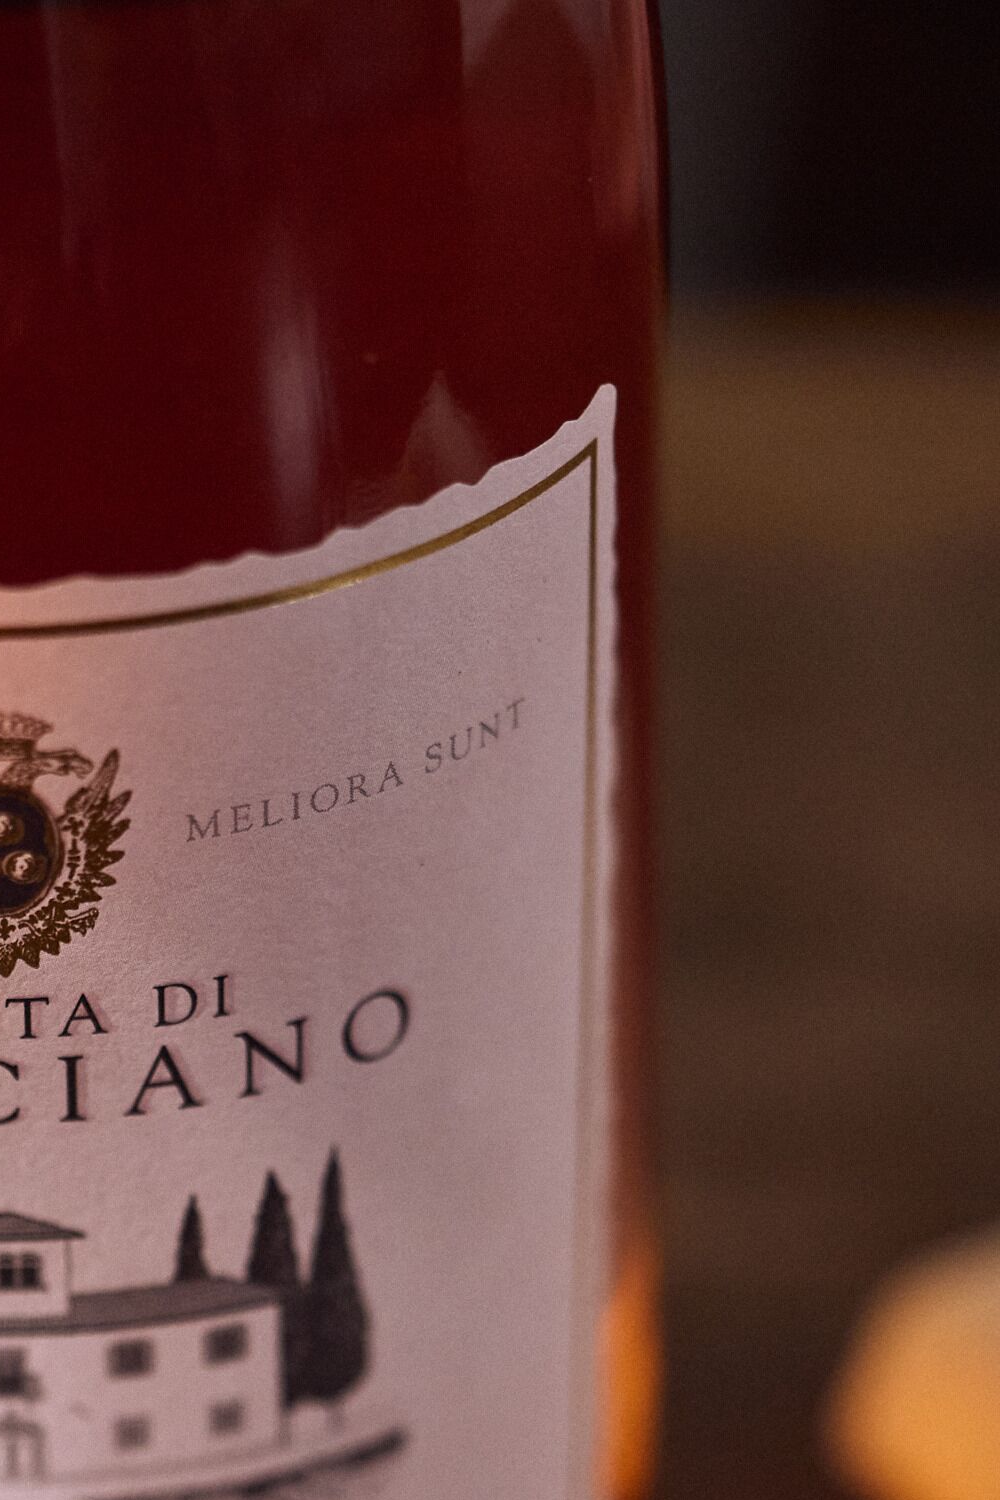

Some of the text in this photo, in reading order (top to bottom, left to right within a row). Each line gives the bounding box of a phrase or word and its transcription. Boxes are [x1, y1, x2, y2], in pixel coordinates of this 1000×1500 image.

[186, 761, 403, 841] MELIORA
[424, 698, 525, 774] SUNT
[153, 974, 234, 1028] DI
